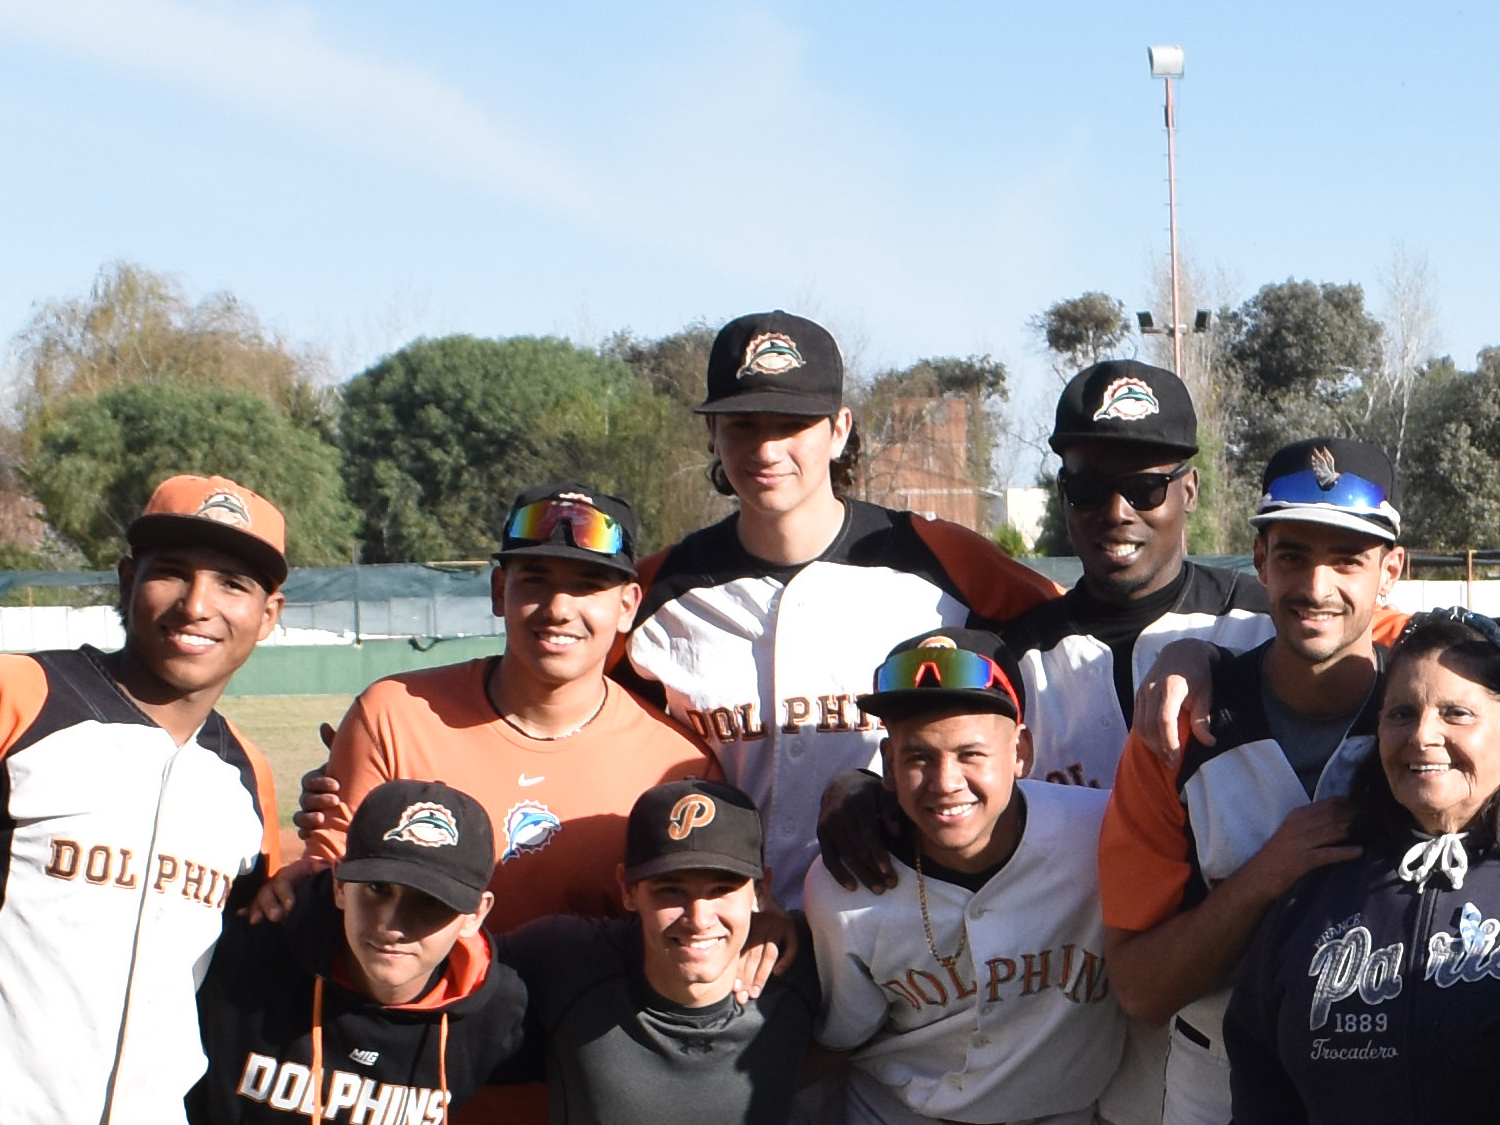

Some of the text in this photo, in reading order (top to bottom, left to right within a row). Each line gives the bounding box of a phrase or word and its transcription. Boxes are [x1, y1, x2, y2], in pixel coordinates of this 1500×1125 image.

[667, 793, 717, 841] P
[1333, 1012, 1388, 1033] 1889
[1310, 1038, 1399, 1060] Trocadero
